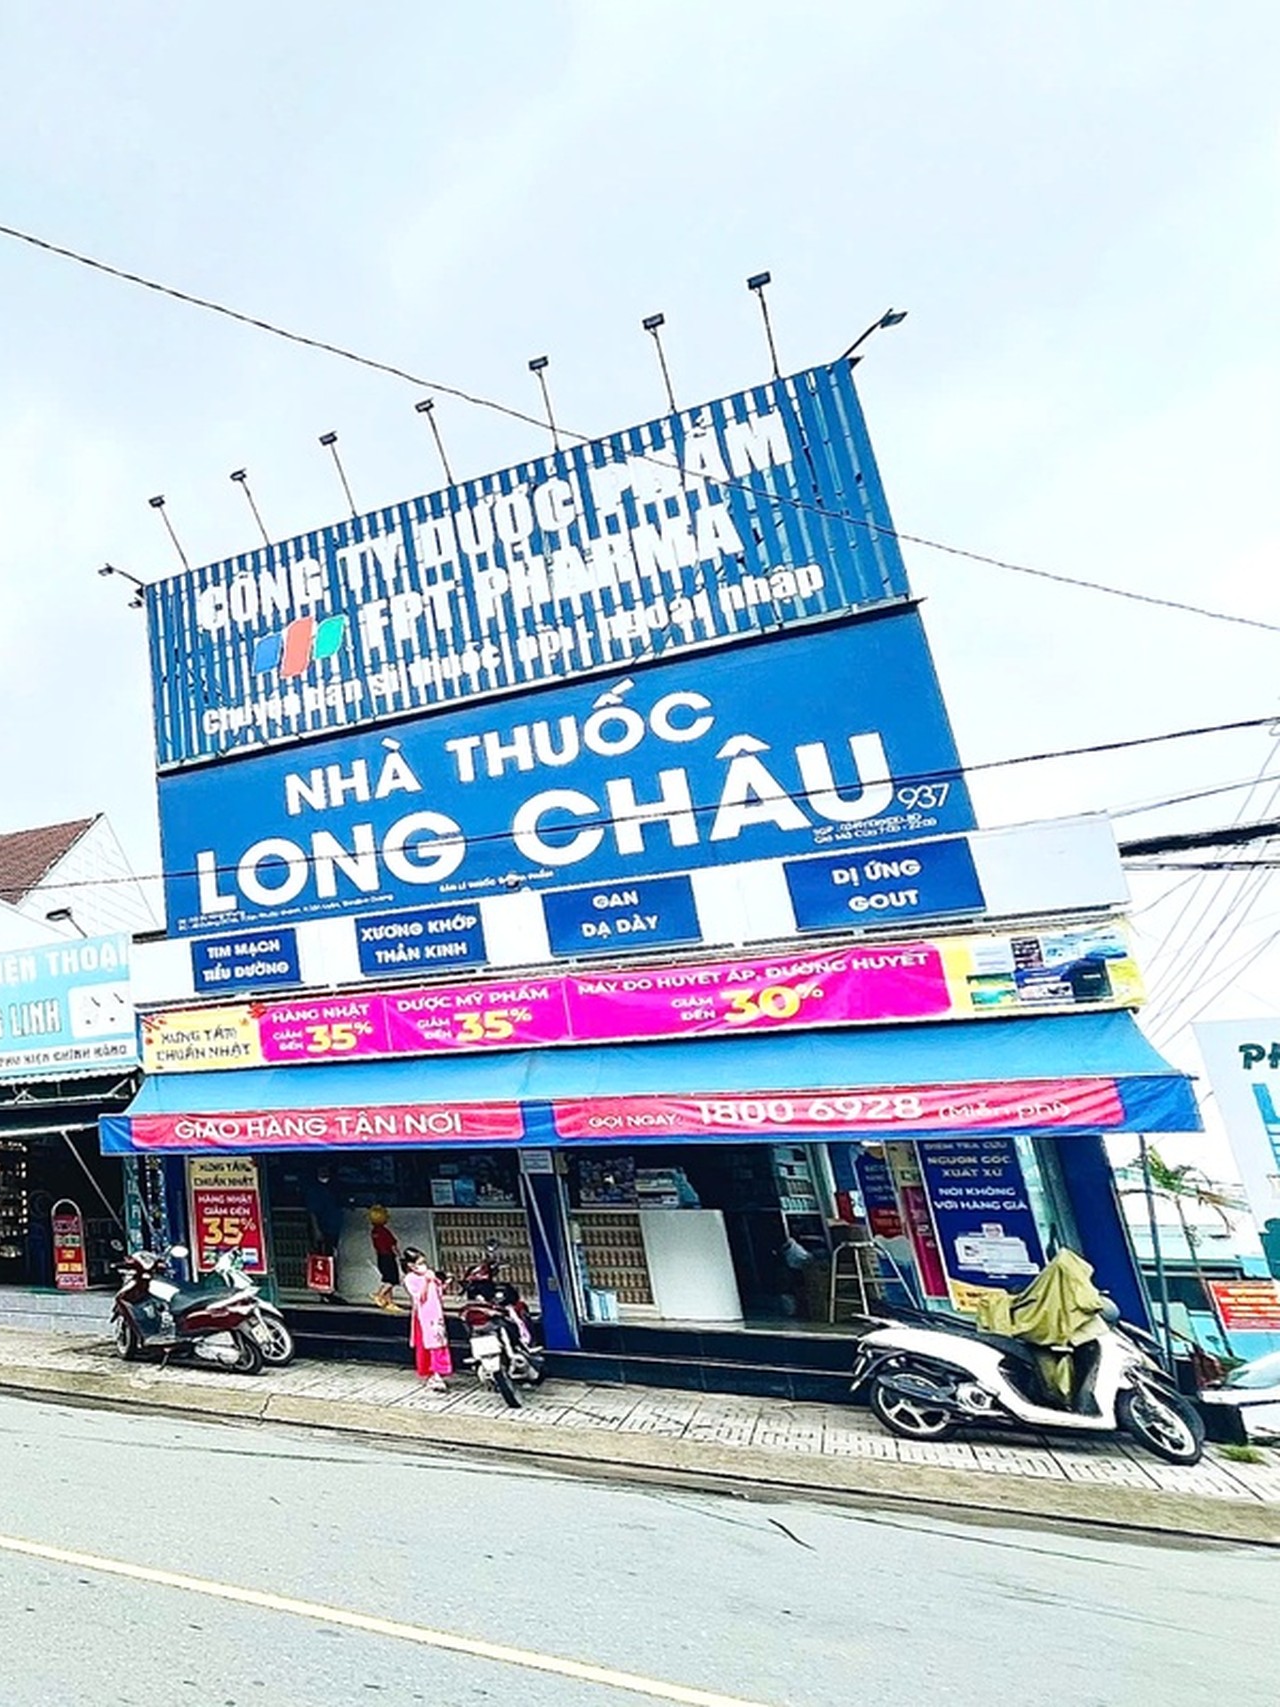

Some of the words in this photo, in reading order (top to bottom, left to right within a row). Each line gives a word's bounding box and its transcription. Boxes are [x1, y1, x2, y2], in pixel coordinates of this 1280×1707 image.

[197, 557, 324, 631] CÔNG
[336, 529, 406, 592] TY
[358, 582, 462, 650] FPT
[477, 503, 744, 622] PHARMA
[284, 737, 420, 816] NHÀ
[445, 678, 717, 783] THUỐC
[896, 782, 949, 811] 937
[194, 811, 469, 916] LONG
[511, 731, 901, 866] CHÂU
[832, 866, 860, 888] DỊ
[866, 858, 922, 882] ỨNG
[592, 890, 639, 910] GAN
[848, 888, 919, 912] GOUT
[360, 919, 424, 942] XƯƠNG
[428, 912, 478, 934] KHỚP
[581, 920, 612, 939] DẠ
[615, 913, 658, 934] DÀY
[45, 942, 128, 977] THOẠI
[206, 944, 231, 959] TIM
[234, 938, 280, 958] MẠCH
[375, 942, 421, 964] THẦN
[425, 942, 468, 959] KINH
[202, 962, 232, 982] TIỂU
[578, 980, 618, 996] MÁY
[852, 951, 930, 972] HUYẾT
[272, 1005, 320, 1024] HÀNG
[323, 1001, 369, 1020] NHẬT
[397, 994, 452, 1014] DƯỢC
[455, 990, 483, 1007] MỸ
[489, 983, 549, 1004] PHẨM
[672, 995, 714, 1009] GIẢM
[721, 983, 824, 1023] 30%
[10, 998, 62, 1037] LINH
[417, 1015, 451, 1030] GIẢM
[453, 1007, 533, 1042] 35%
[306, 1020, 373, 1053] 35%
[174, 1121, 240, 1140] GIAO
[246, 1115, 329, 1139] HÀNG
[335, 1111, 398, 1141] TẬN
[405, 1112, 462, 1134] NƠI
[588, 1114, 625, 1131] GỌI
[697, 1100, 794, 1126] 1800
[808, 1097, 924, 1122] 6928
[202, 1216, 257, 1245] 35%
